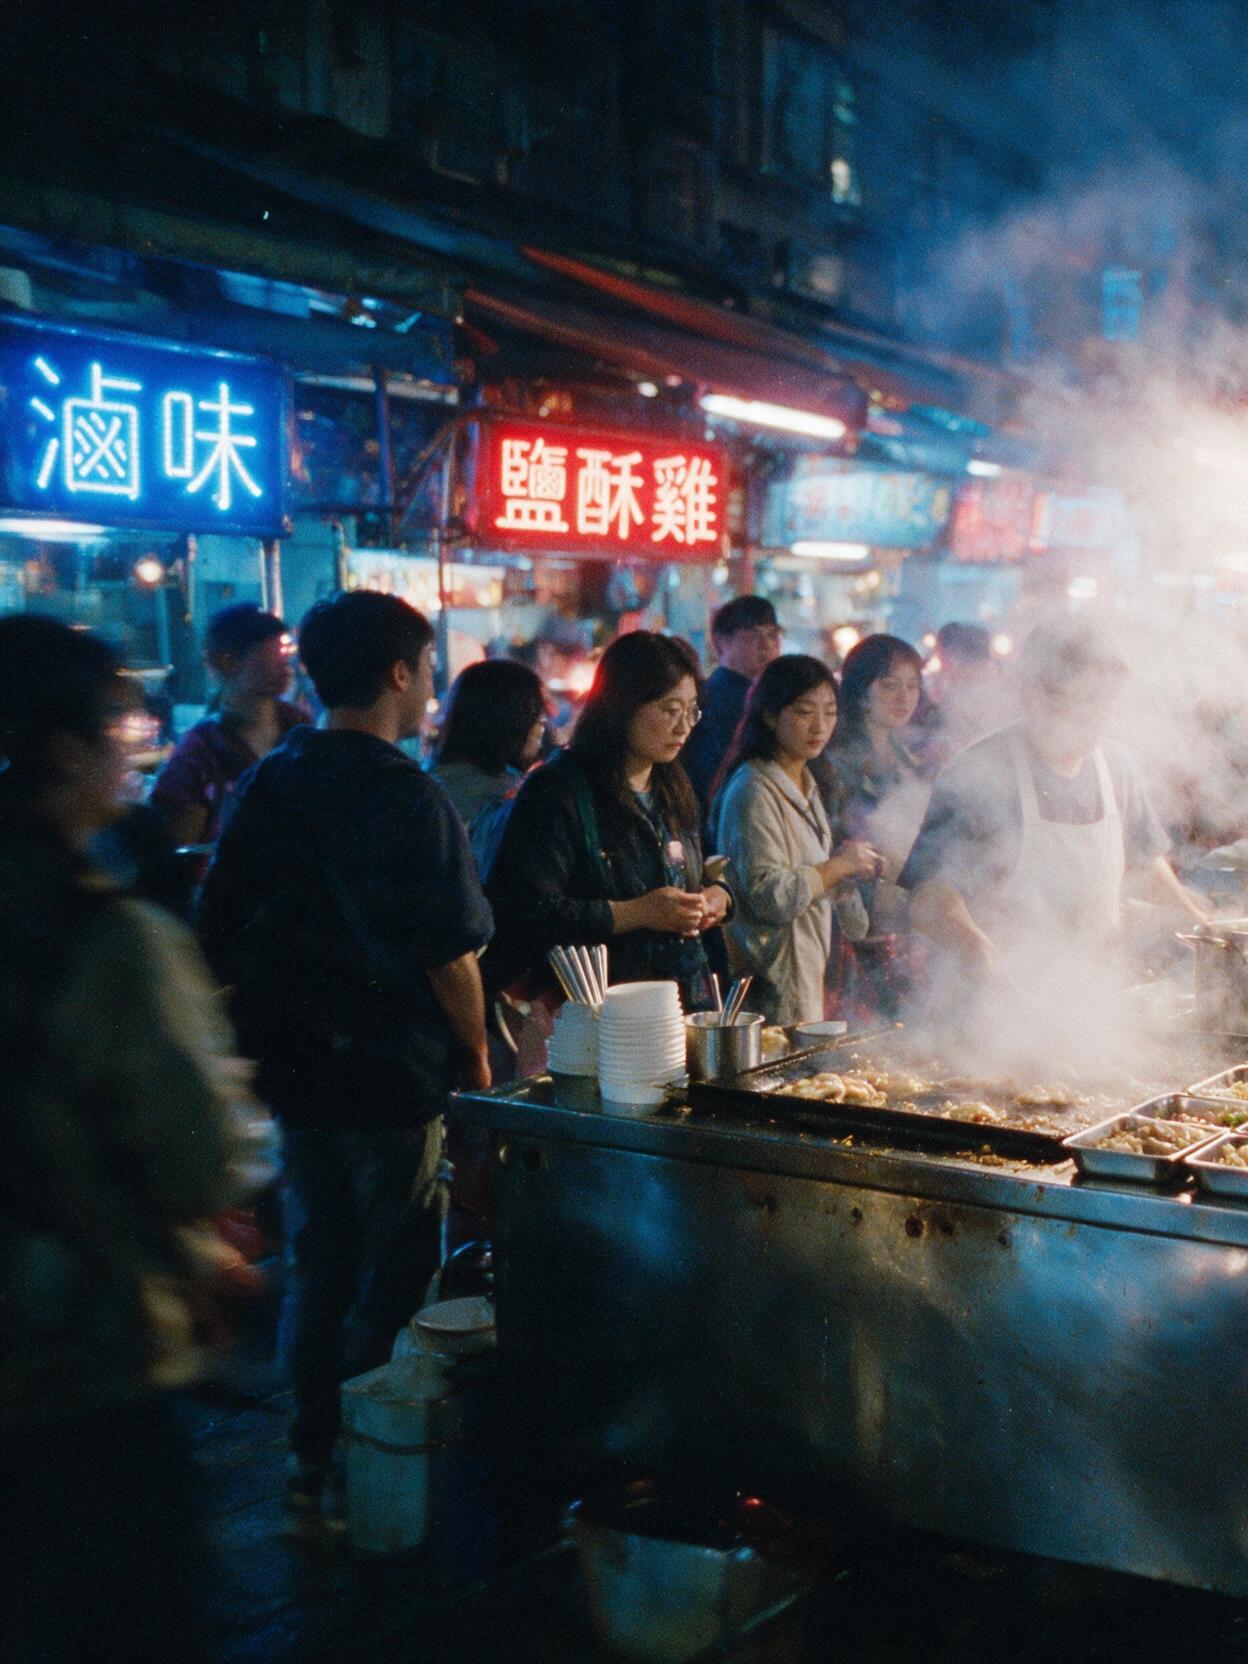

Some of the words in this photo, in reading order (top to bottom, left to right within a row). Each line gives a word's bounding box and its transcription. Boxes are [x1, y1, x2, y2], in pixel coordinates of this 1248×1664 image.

[31, 356, 262, 511] 滷味
[495, 437, 718, 545] 鹽酥雞
